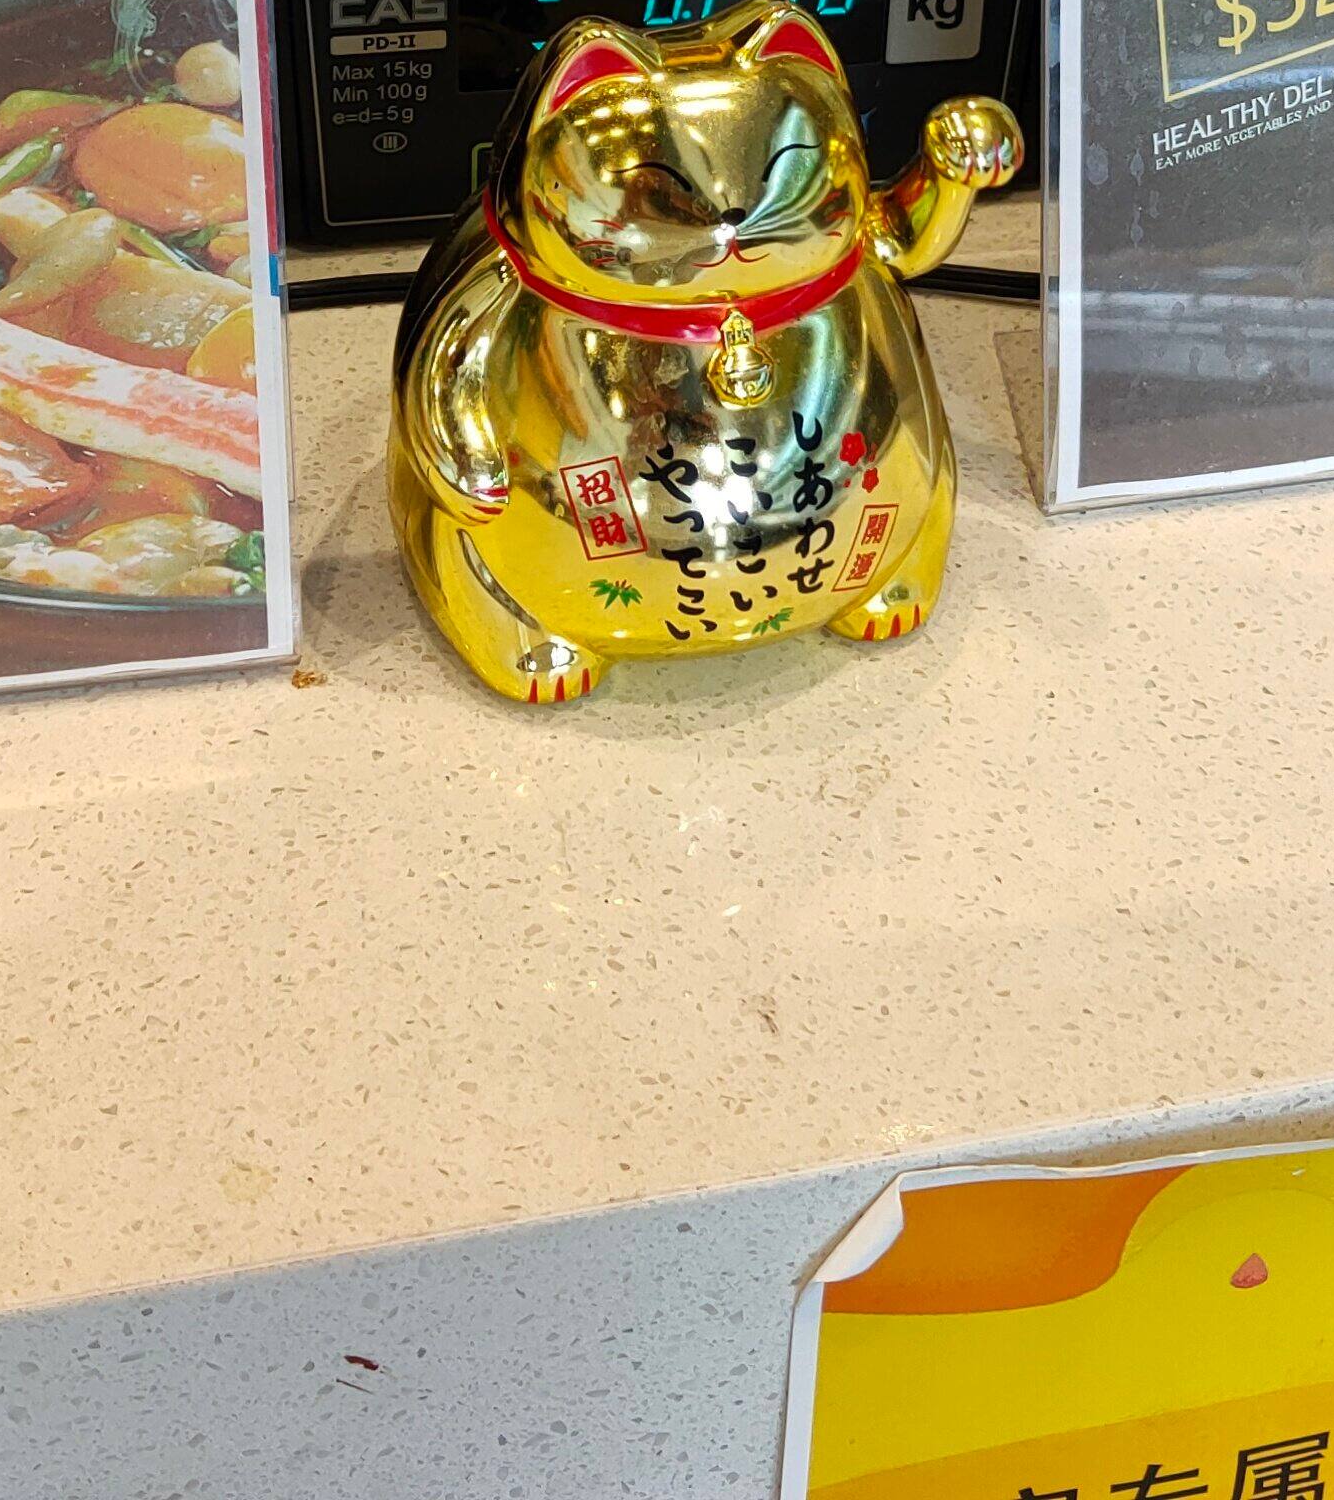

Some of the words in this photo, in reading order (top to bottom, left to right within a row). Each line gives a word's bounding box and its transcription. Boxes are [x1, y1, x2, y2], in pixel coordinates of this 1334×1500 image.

[332, 64, 375, 81] Max
[332, 86, 368, 103] Min
[1152, 92, 1274, 155] HEALTHY
[1155, 154, 1181, 170] EAT
[1186, 140, 1221, 161] MORE
[1224, 111, 1302, 147] VEGETABLES
[1305, 101, 1332, 119] AND
[576, 470, 627, 547] 招財
[725, 437, 777, 612] こいこい
[787, 411, 835, 594] しあわせ
[639, 443, 717, 641] やってこい
